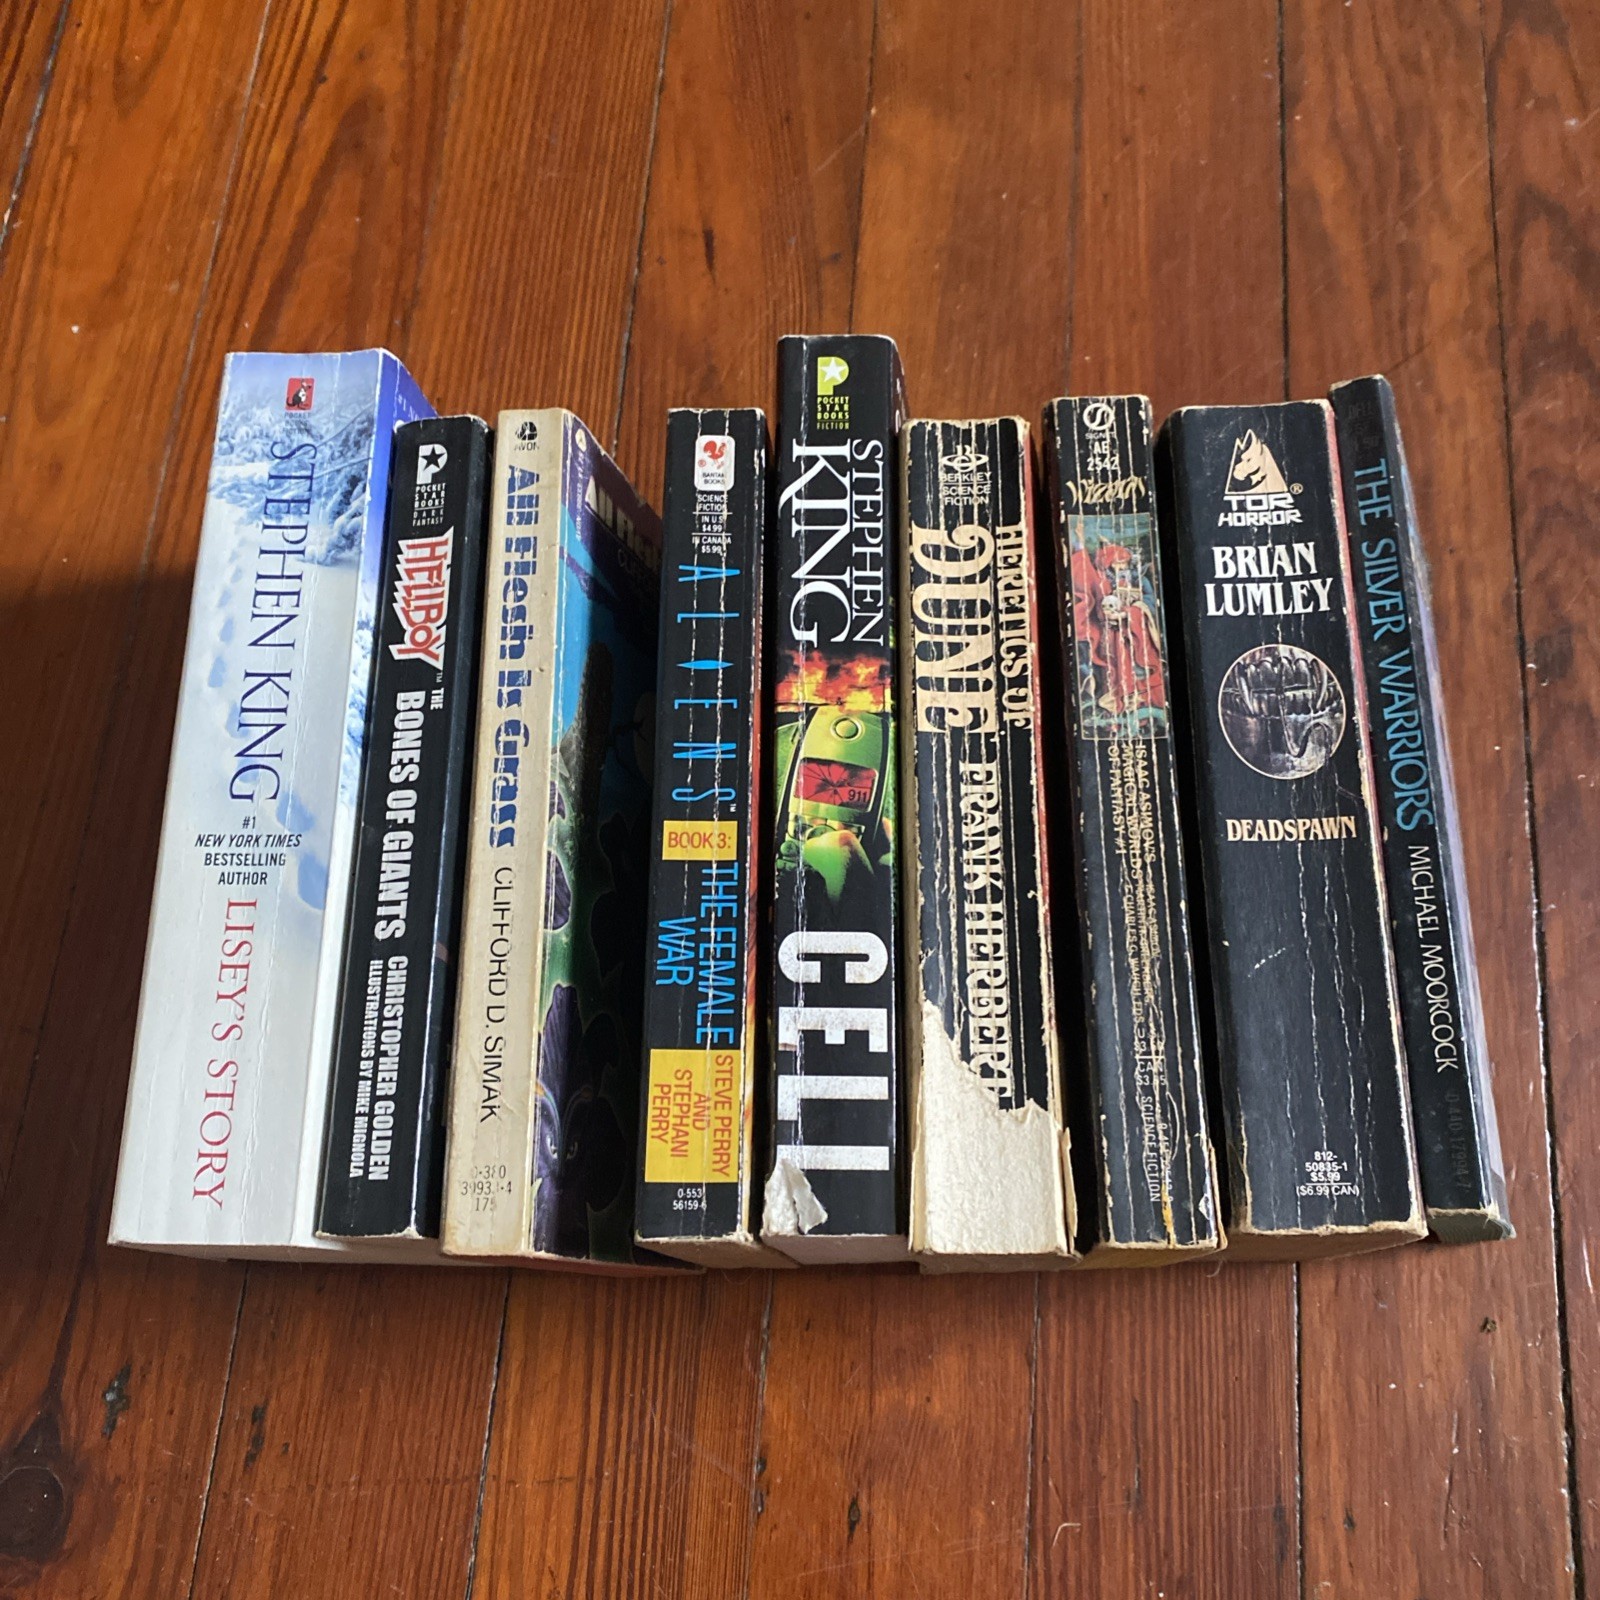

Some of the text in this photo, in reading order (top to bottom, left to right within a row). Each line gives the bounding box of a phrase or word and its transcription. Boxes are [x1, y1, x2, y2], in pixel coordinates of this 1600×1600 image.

[817, 396, 850, 404] POCKET
[817, 412, 850, 420] BOOKS
[816, 422, 850, 430] FICTION
[1085, 431, 1117, 440] SIGNT
[940, 471, 992, 482] BERKLEY
[1087, 457, 1119, 471] 2542
[414, 498, 445, 508] BOOKS
[415, 483, 446, 493] POCKET
[415, 490, 445, 500] STAR
[697, 494, 729, 503] SCIENCE
[942, 485, 991, 496] SCIENCE
[944, 496, 990, 506] FICTION
[1223, 493, 1295, 511] TOR
[1354, 458, 1394, 526] THE
[412, 517, 444, 527] FANTASY
[413, 509, 444, 518] DARK
[1217, 509, 1304, 527] HORROR
[701, 536, 732, 544] CANADA
[777, 438, 851, 649] KING
[852, 438, 885, 647] STEPHEN
[1212, 541, 1318, 579] BRIAN
[391, 528, 453, 669] HELLBOY
[1204, 577, 1334, 616] LUMLEY
[1361, 537, 1407, 642] SILVER
[228, 441, 318, 802] STEPHEN KING
[911, 520, 998, 733] DUNE
[996, 524, 1034, 729] HERETICS OF
[489, 465, 540, 848] All Flesh Is Grass
[430, 688, 444, 711] THE
[671, 564, 741, 801] ALIENS
[1108, 746, 1121, 768] OF
[1379, 648, 1435, 831] WARRIORS
[848, 789, 868, 802] 911
[1110, 769, 1126, 835] FANTASY
[1121, 743, 1144, 880] MAGICAL WORLDS
[1134, 744, 1157, 863] ISAAC ASIMOV'S
[242, 816, 256, 829] #1
[374, 691, 426, 941] BONES OF GIANTS
[1225, 815, 1357, 841] DEADSPAWN
[195, 834, 303, 848] NEW YORK TIMES
[667, 831, 714, 849] BOOK
[204, 853, 286, 866] BESTSELLING
[218, 872, 268, 885] AUTHOR
[959, 760, 1014, 1098] FRANK HERBERT
[656, 917, 697, 985] WAR
[696, 862, 739, 1044] THE FEMALE
[1408, 845, 1459, 1073] MICHAEL MOORCOCK
[480, 867, 515, 1123] CLIFFORD D. SIMAK
[193, 898, 258, 1210] LISEY'S STORY
[350, 960, 383, 1179] ILLUSTRATIONS BY MIKE MIGNOLA
[368, 956, 409, 1181] CHRISTOPHER GOLDEN
[776, 931, 890, 1171] CELL
[651, 1083, 672, 1145] PERRY
[670, 1069, 693, 1158] STEPHANI
[692, 1092, 711, 1131] AND
[711, 1054, 734, 1178] STEVE PERRY
[1140, 1096, 1161, 1203] SCIENCE FICTION
[1305, 1161, 1348, 1173] 50835-1
[1314, 1150, 1338, 1161] 812-
[1296, 1184, 1360, 1197] ($6.99 CAN)
[1310, 1172, 1341, 1182] $5.99
